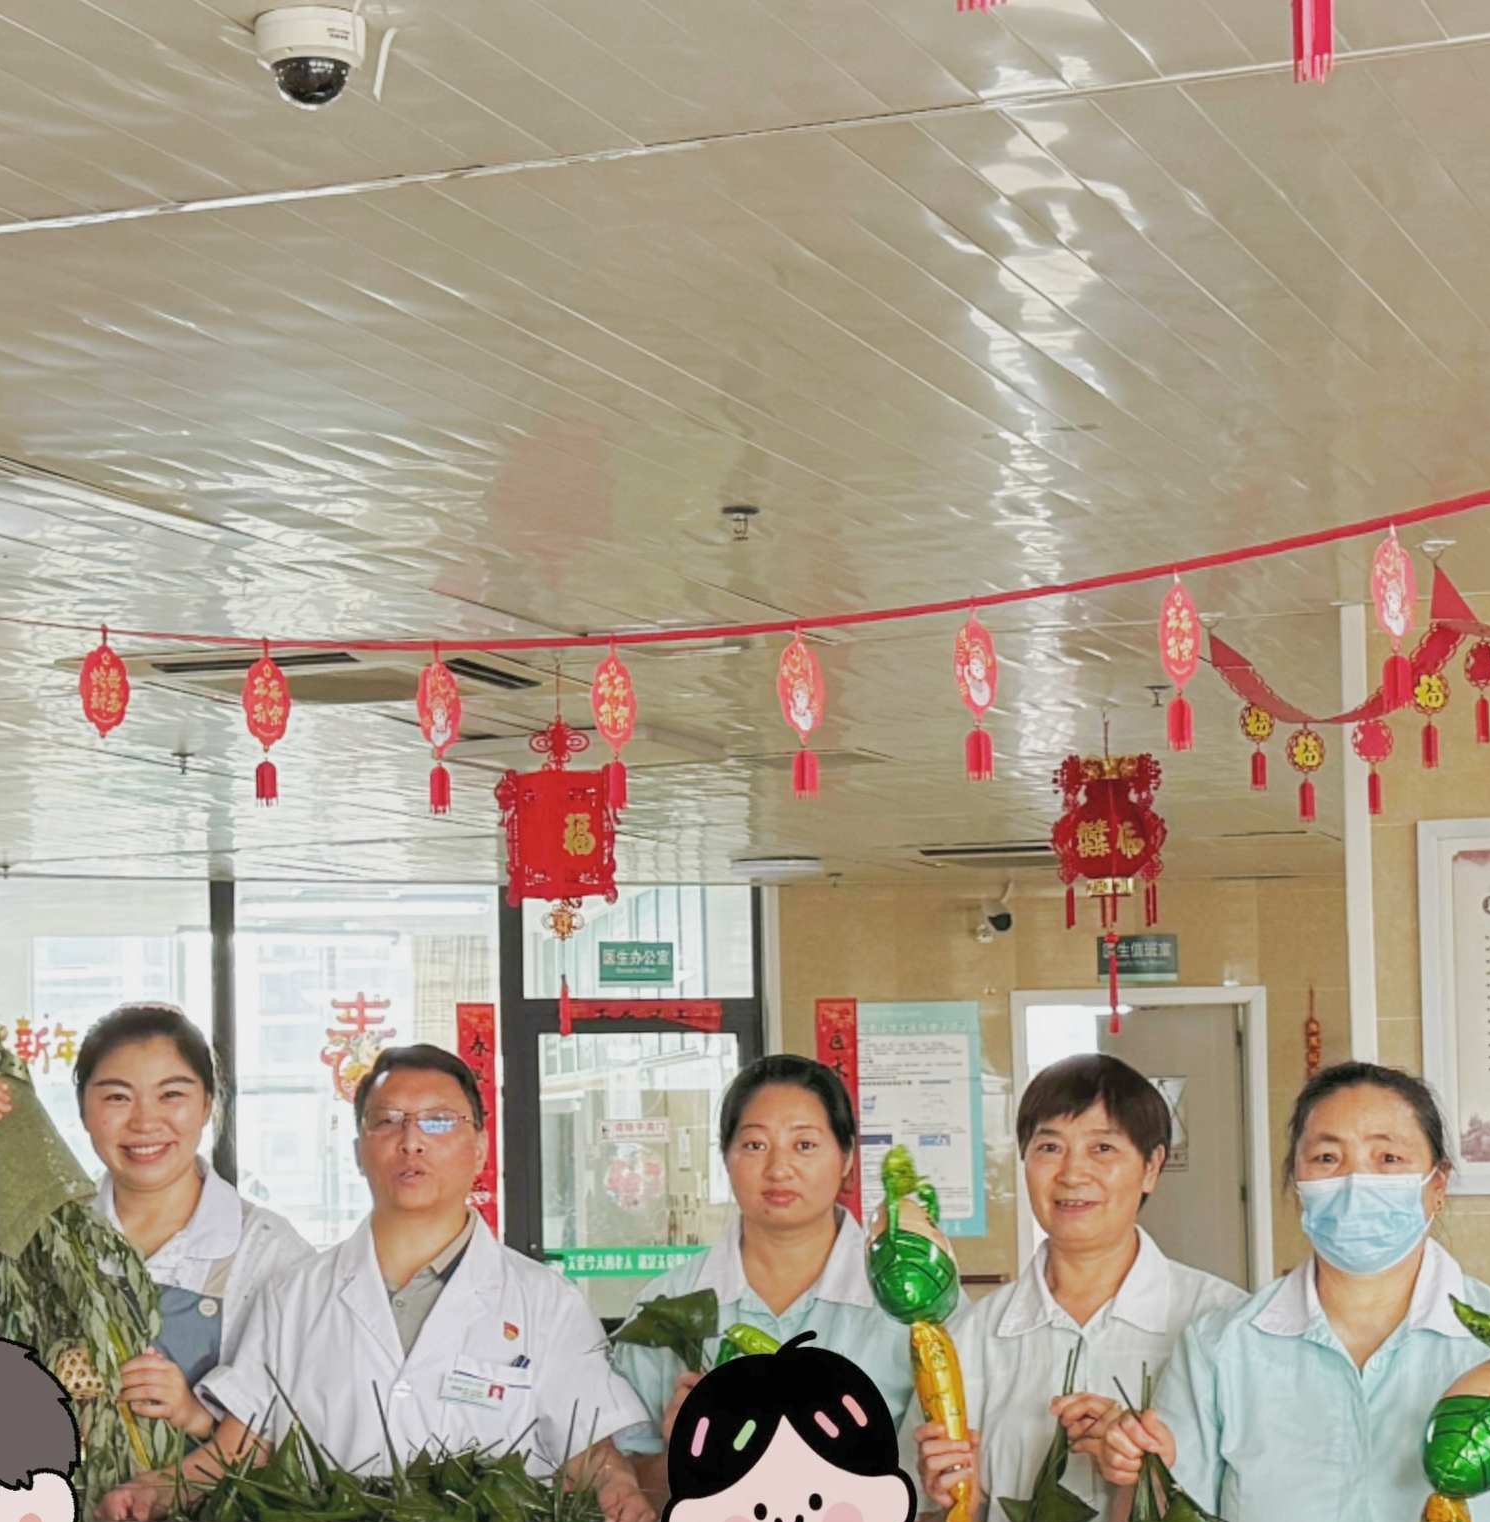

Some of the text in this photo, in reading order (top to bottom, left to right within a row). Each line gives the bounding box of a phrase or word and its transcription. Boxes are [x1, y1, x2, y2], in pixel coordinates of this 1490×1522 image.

[1413, 672, 1450, 713] 福
[1292, 732, 1322, 769] 福
[564, 813, 597, 857] 福
[602, 948, 670, 966] 医生办公室
